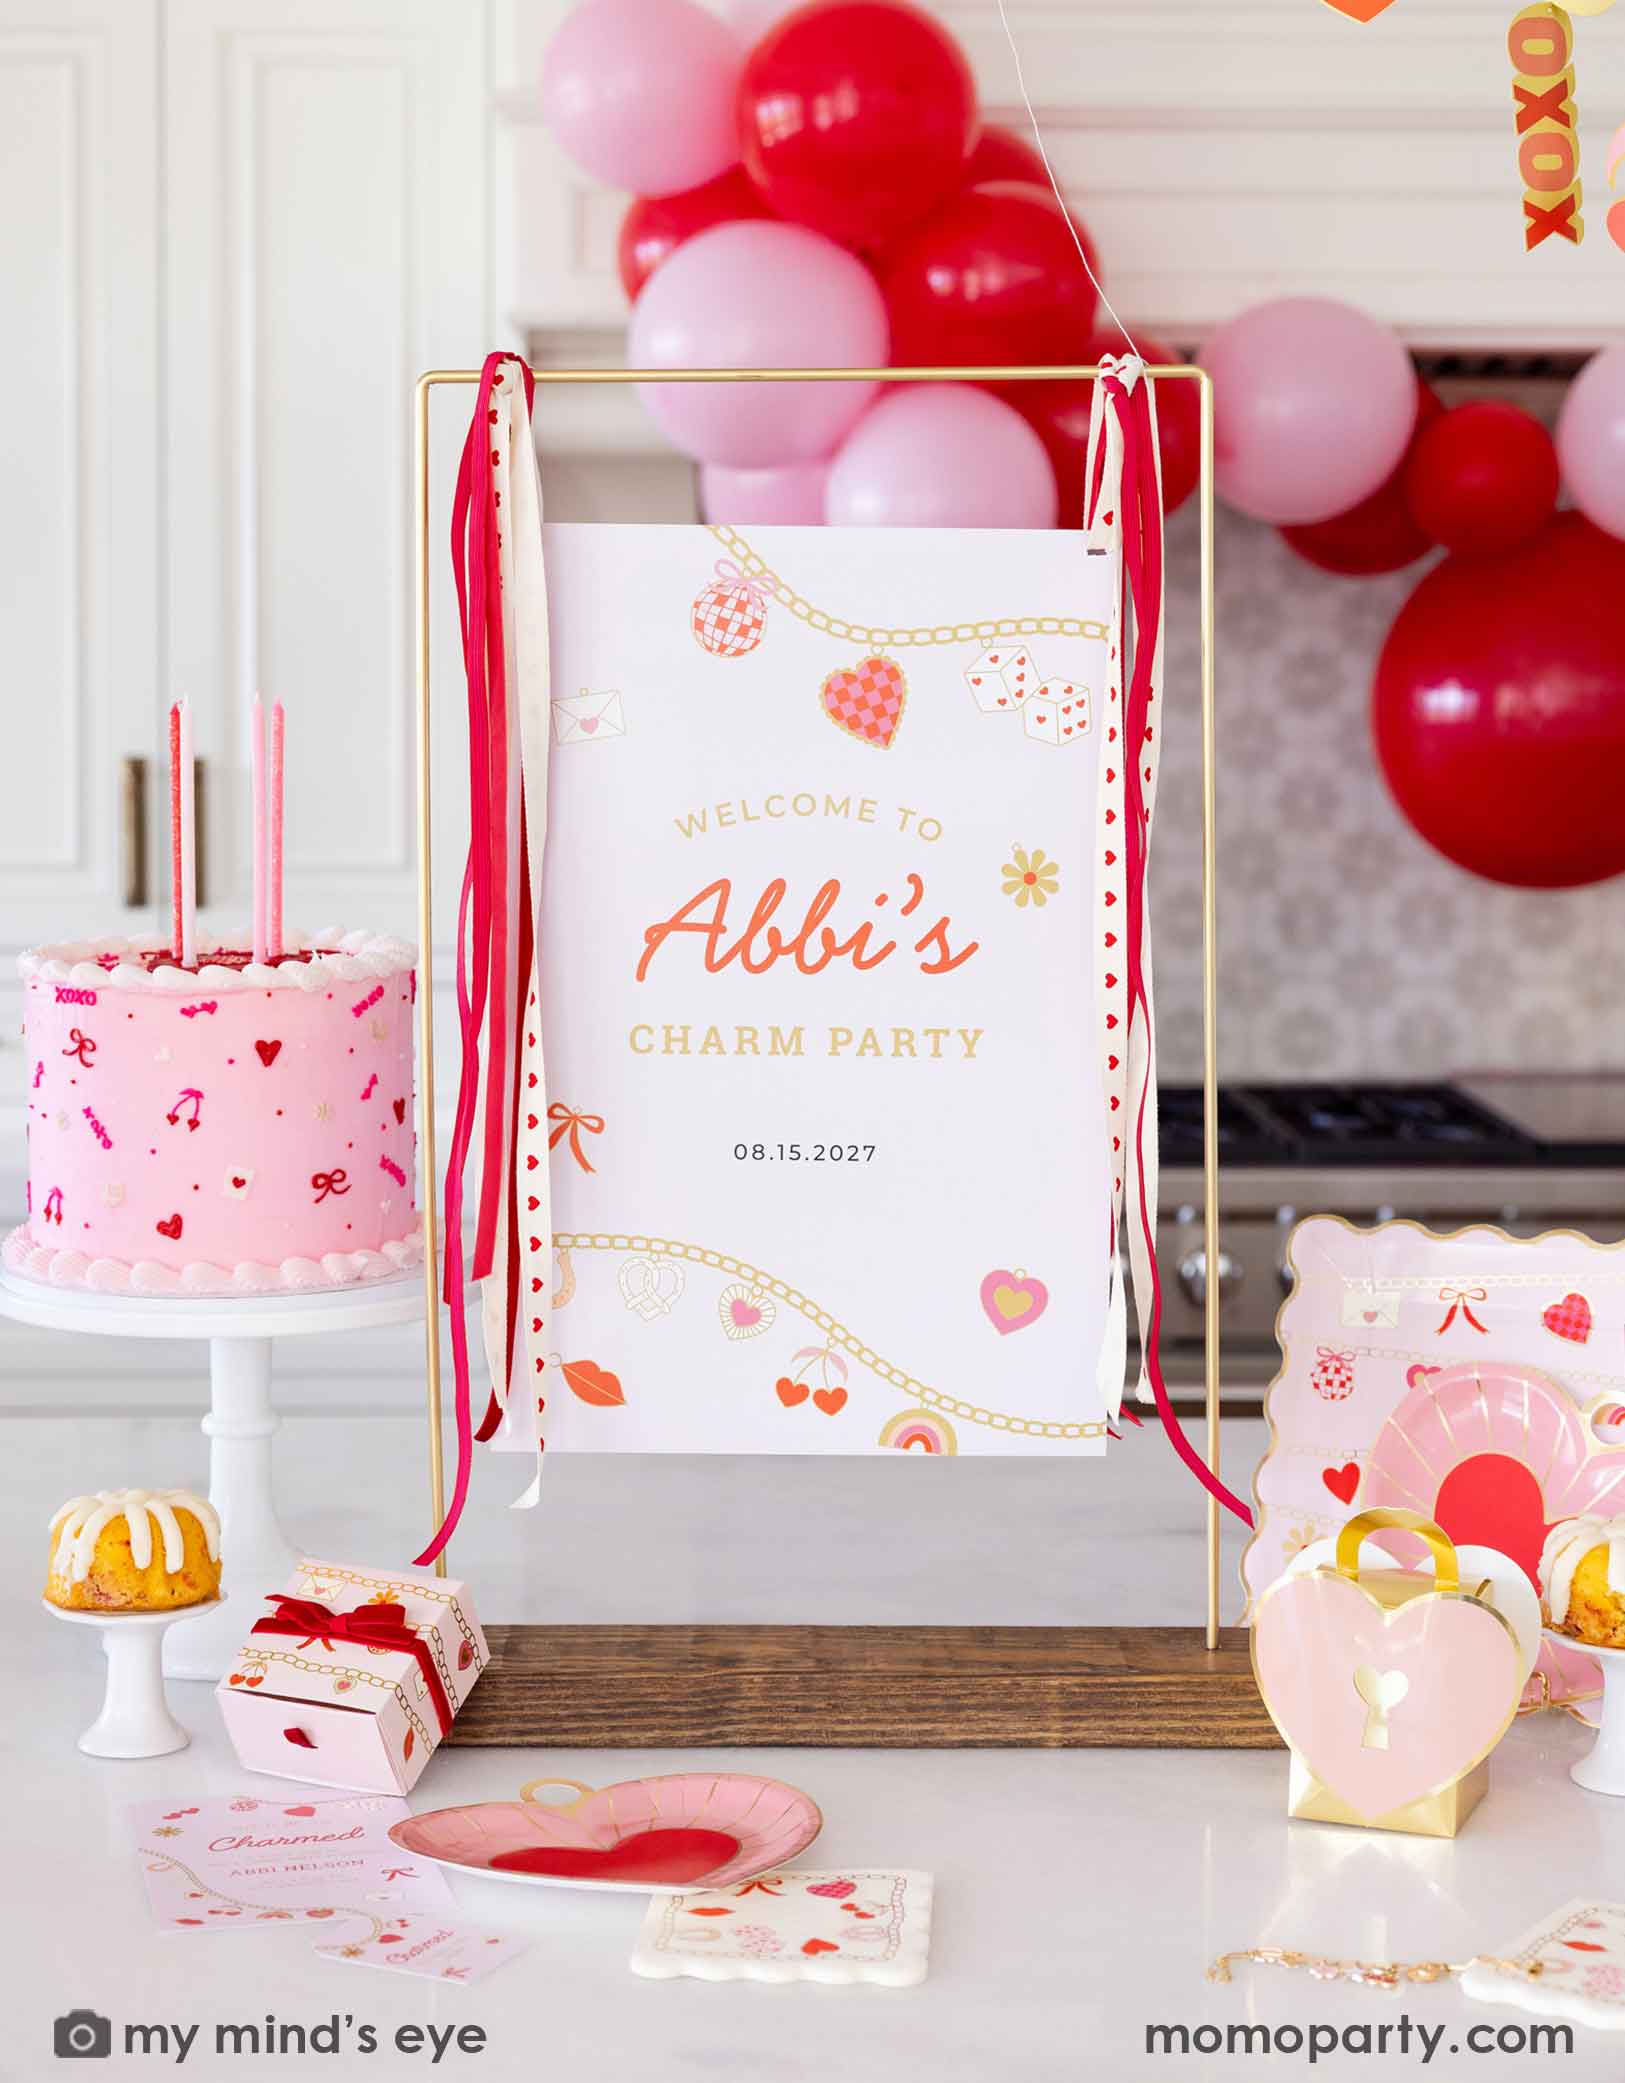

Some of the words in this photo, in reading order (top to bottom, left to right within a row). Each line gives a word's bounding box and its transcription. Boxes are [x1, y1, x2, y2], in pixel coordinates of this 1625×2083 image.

[674, 792, 879, 840] WELCOME
[896, 806, 944, 843] TO
[635, 872, 979, 983] Abbi's
[629, 1023, 806, 1057] CHARM
[827, 1026, 985, 1059] PARTY
[733, 1143, 877, 1163] 08.15.2027
[207, 1824, 367, 1853] Charmed
[284, 1859, 367, 1873] NELSON
